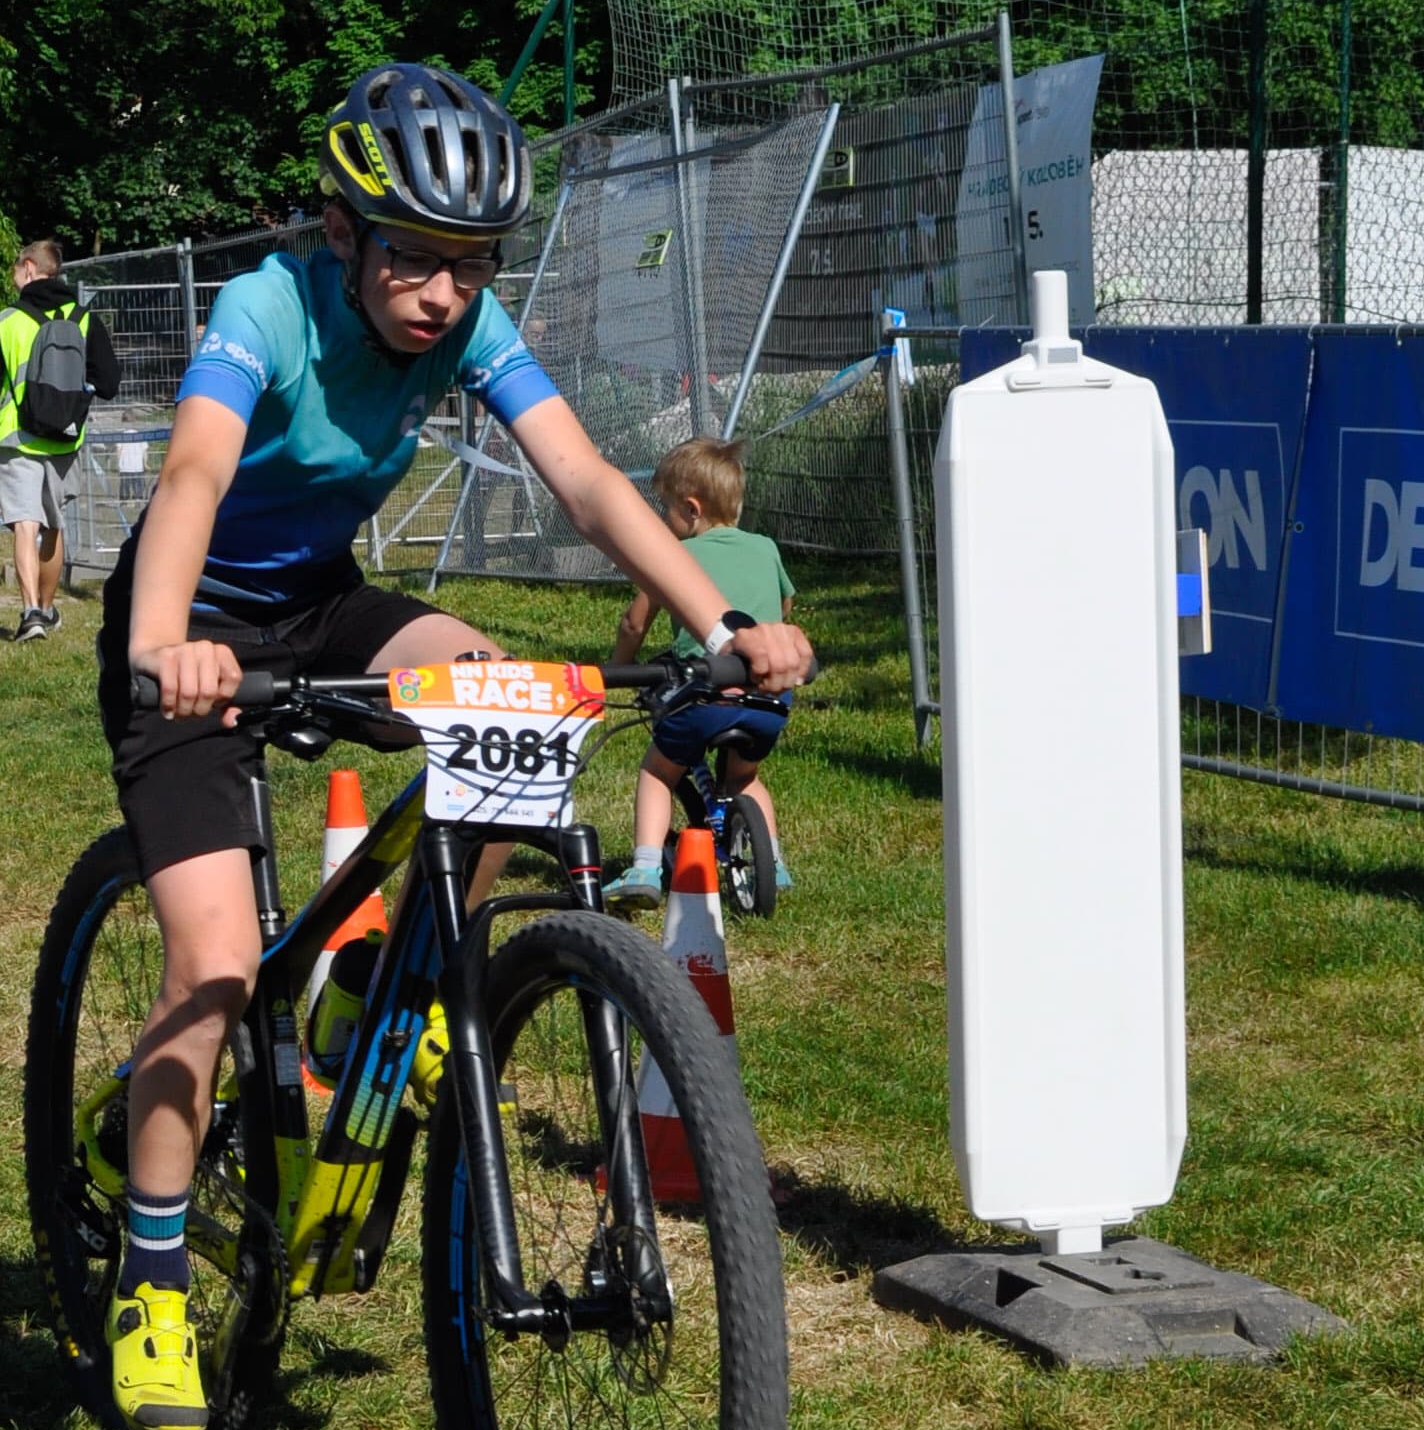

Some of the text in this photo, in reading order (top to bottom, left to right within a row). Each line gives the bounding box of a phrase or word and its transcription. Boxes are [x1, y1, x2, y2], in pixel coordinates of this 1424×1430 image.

[357, 122, 394, 187] SCOTT
[486, 665, 535, 680] KIDS
[453, 679, 553, 711] RACE
[446, 723, 571, 777] 2081
